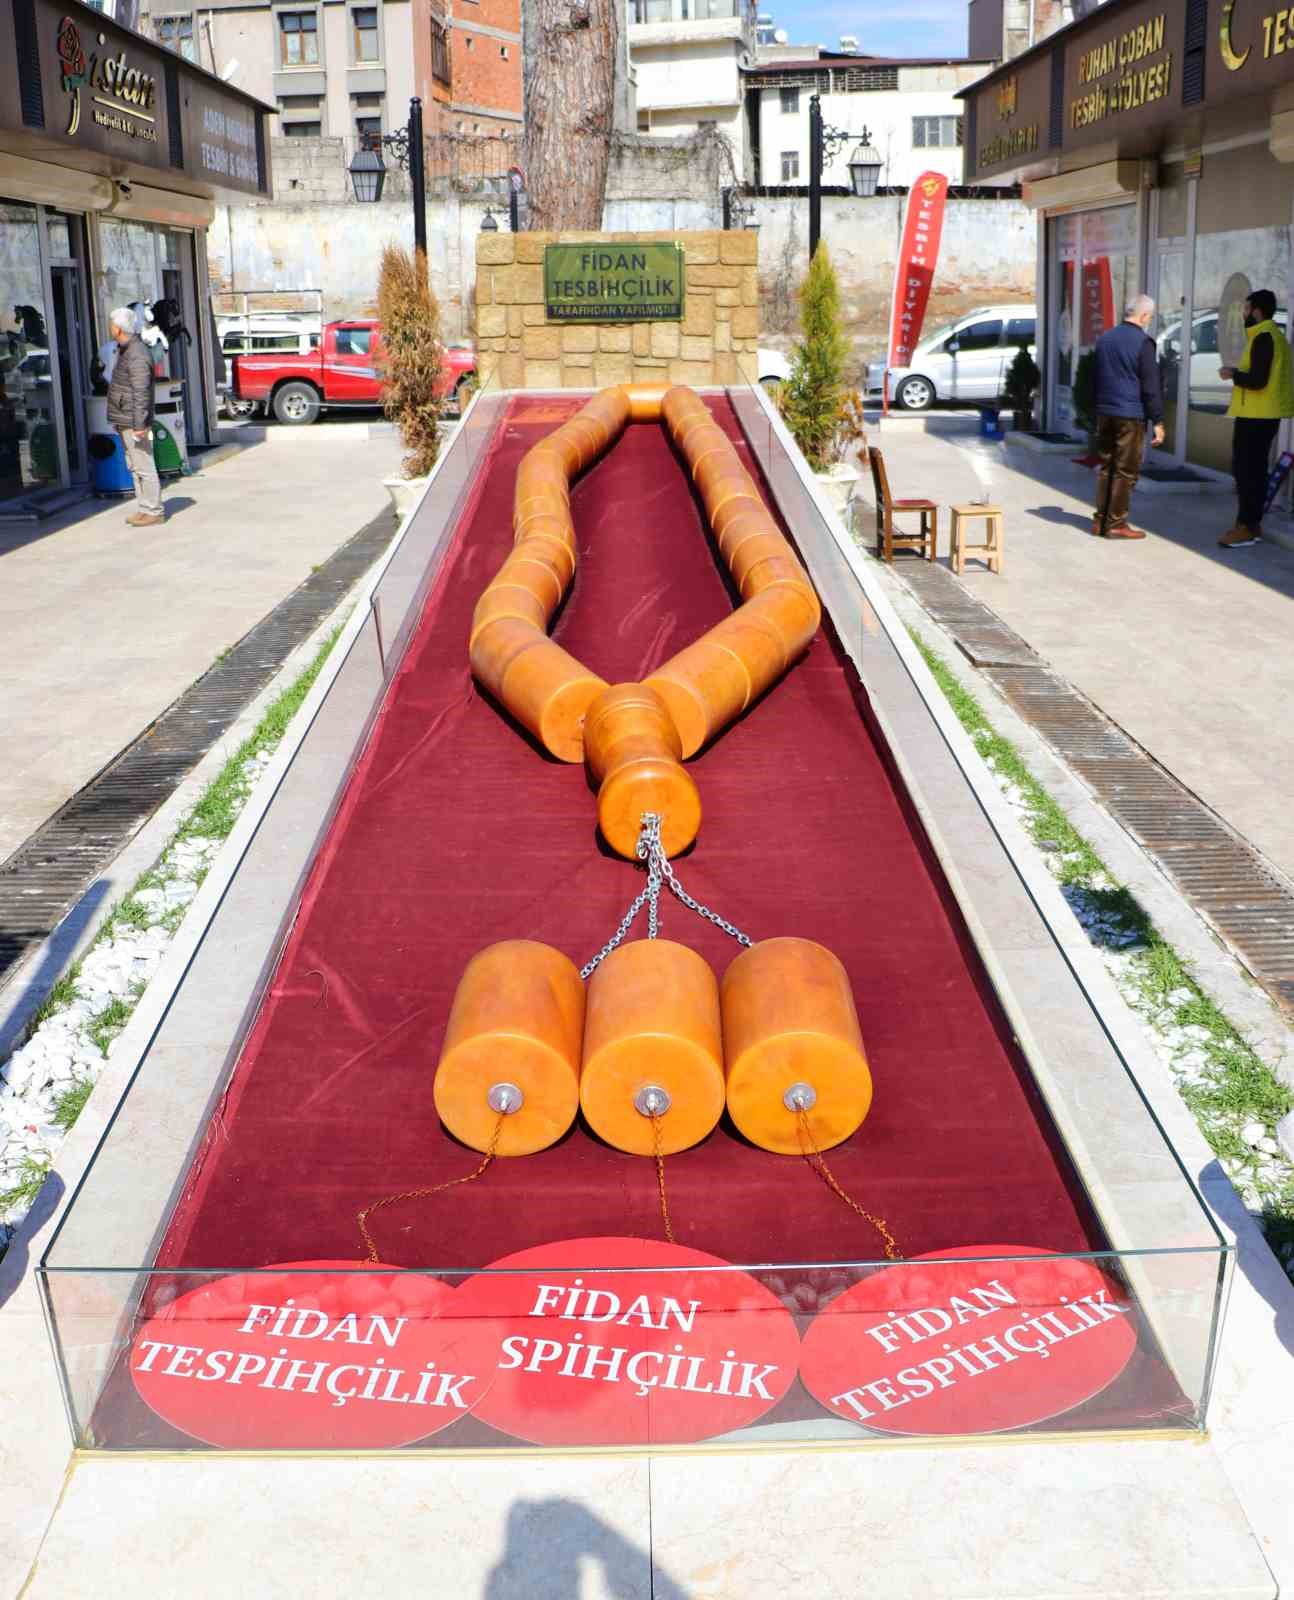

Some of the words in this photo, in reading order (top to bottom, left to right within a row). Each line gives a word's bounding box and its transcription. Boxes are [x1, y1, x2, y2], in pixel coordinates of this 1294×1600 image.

[1079, 37, 1117, 84] RUHAN
[1119, 13, 1165, 77] ÇOBAN
[552, 276, 675, 300] TESBİHÇİLİK
[580, 251, 647, 272] FİDAN
[237, 1298, 409, 1348] FİDAN
[528, 1278, 702, 1333] FİDAN
[864, 1279, 1018, 1354] FİDAN
[134, 1340, 476, 1409] TESPİHÇİLİK
[831, 1288, 1130, 1420] TESPİHÇİLİK
